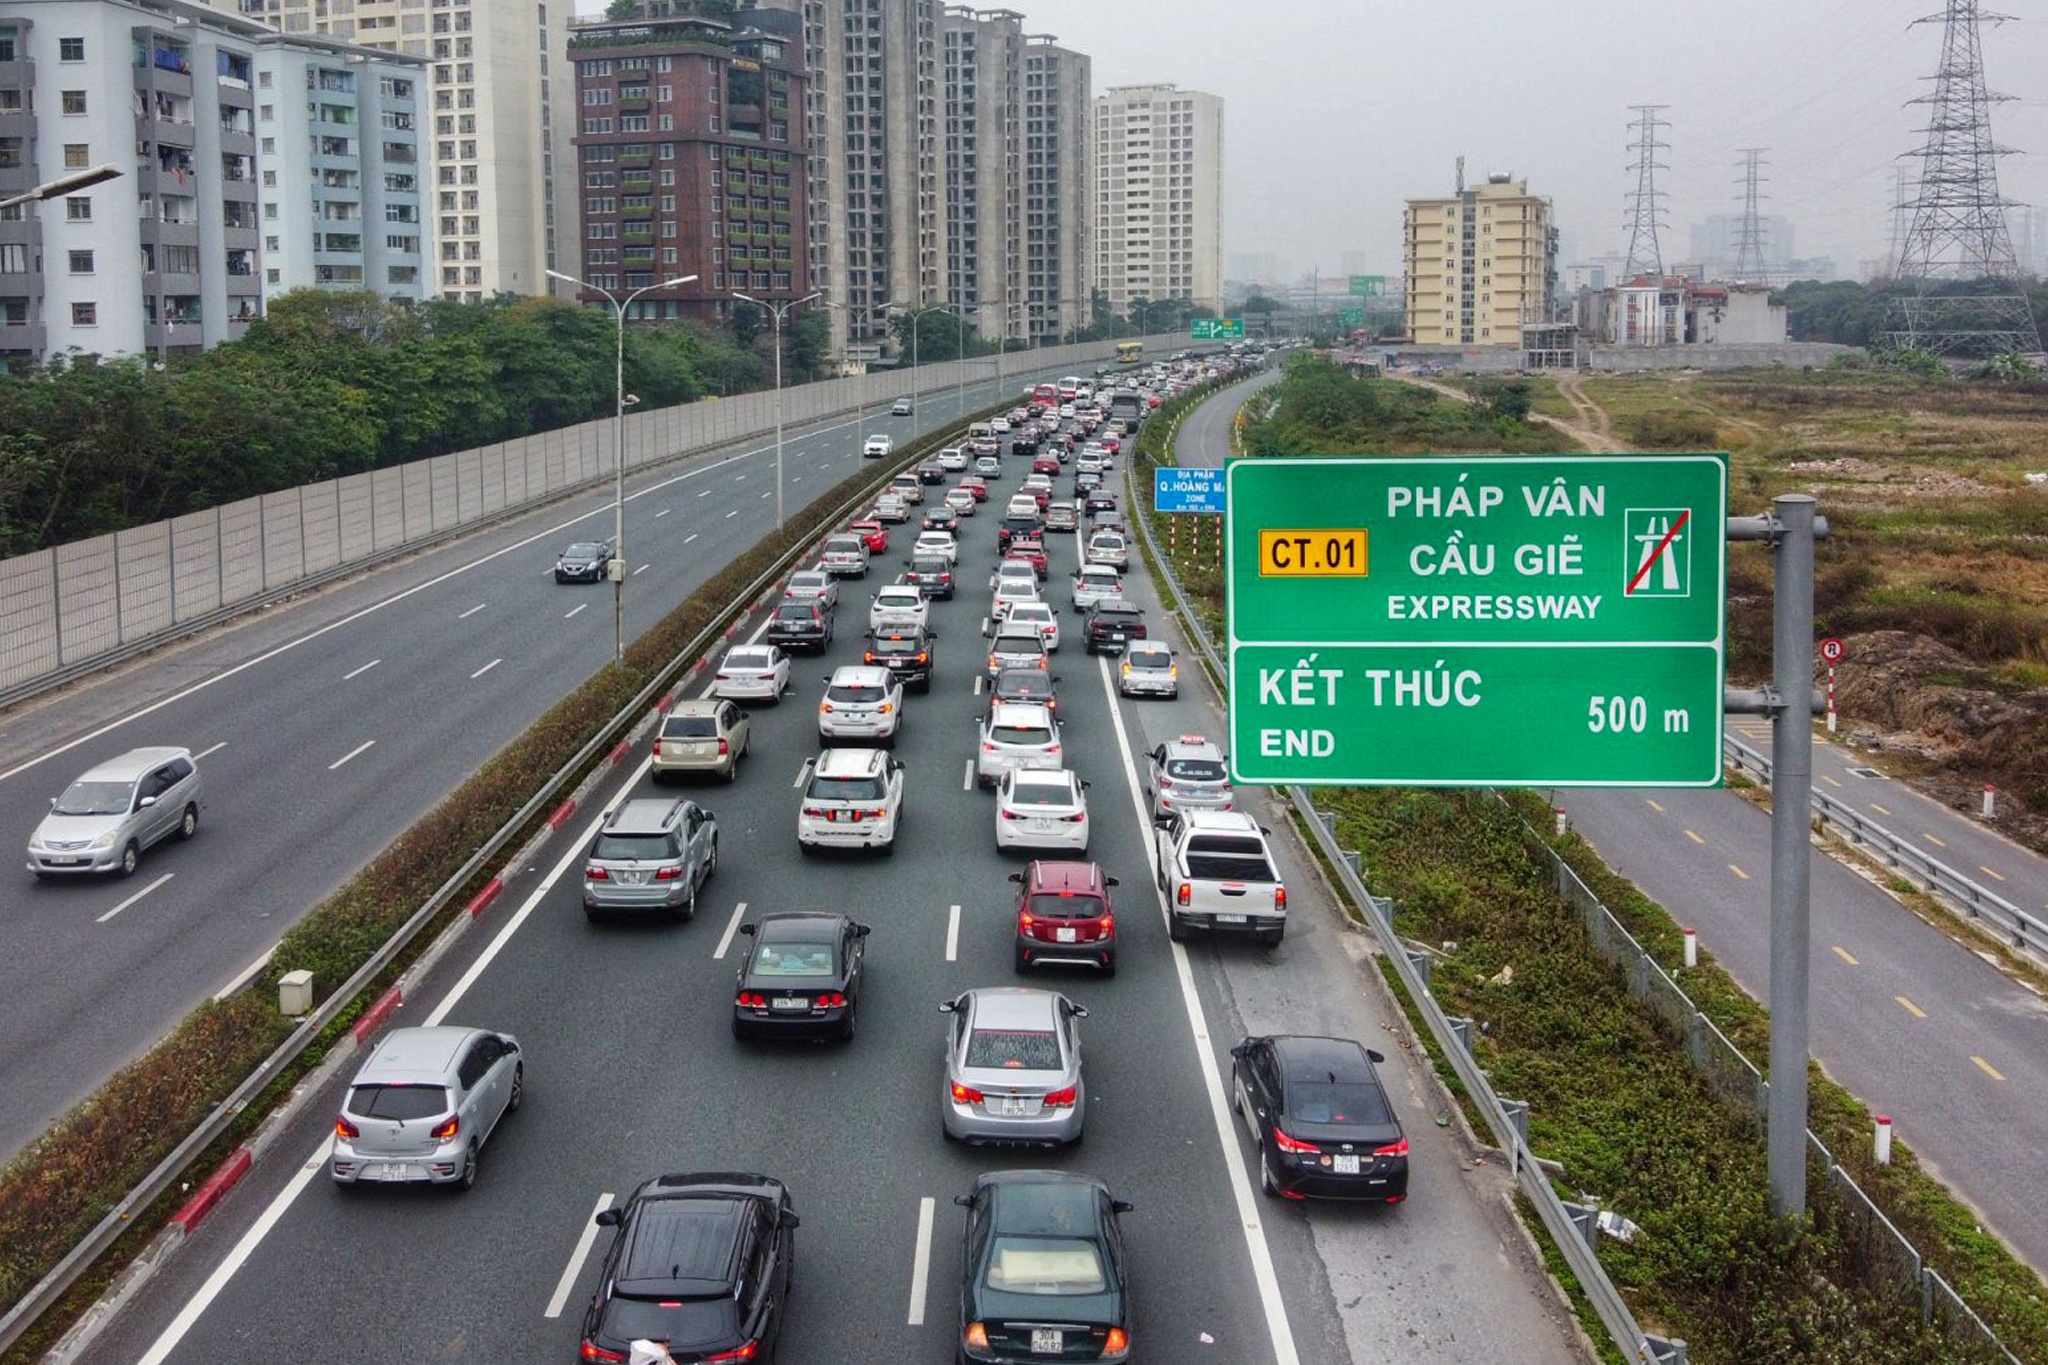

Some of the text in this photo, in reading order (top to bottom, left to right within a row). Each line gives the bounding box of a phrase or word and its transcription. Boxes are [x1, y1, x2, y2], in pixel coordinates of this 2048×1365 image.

[1185, 494, 1206, 503] ZONE
[1388, 473, 1605, 518] PHÁP VÂN
[1271, 538, 1355, 568] CT.01
[1409, 529, 1584, 576] CẦU GIẼ
[1388, 595, 1602, 620] EXPRESSWAY
[1259, 653, 1482, 707] KẾT THÚC
[1588, 695, 1689, 733] 500 m
[1260, 728, 1335, 757] END
